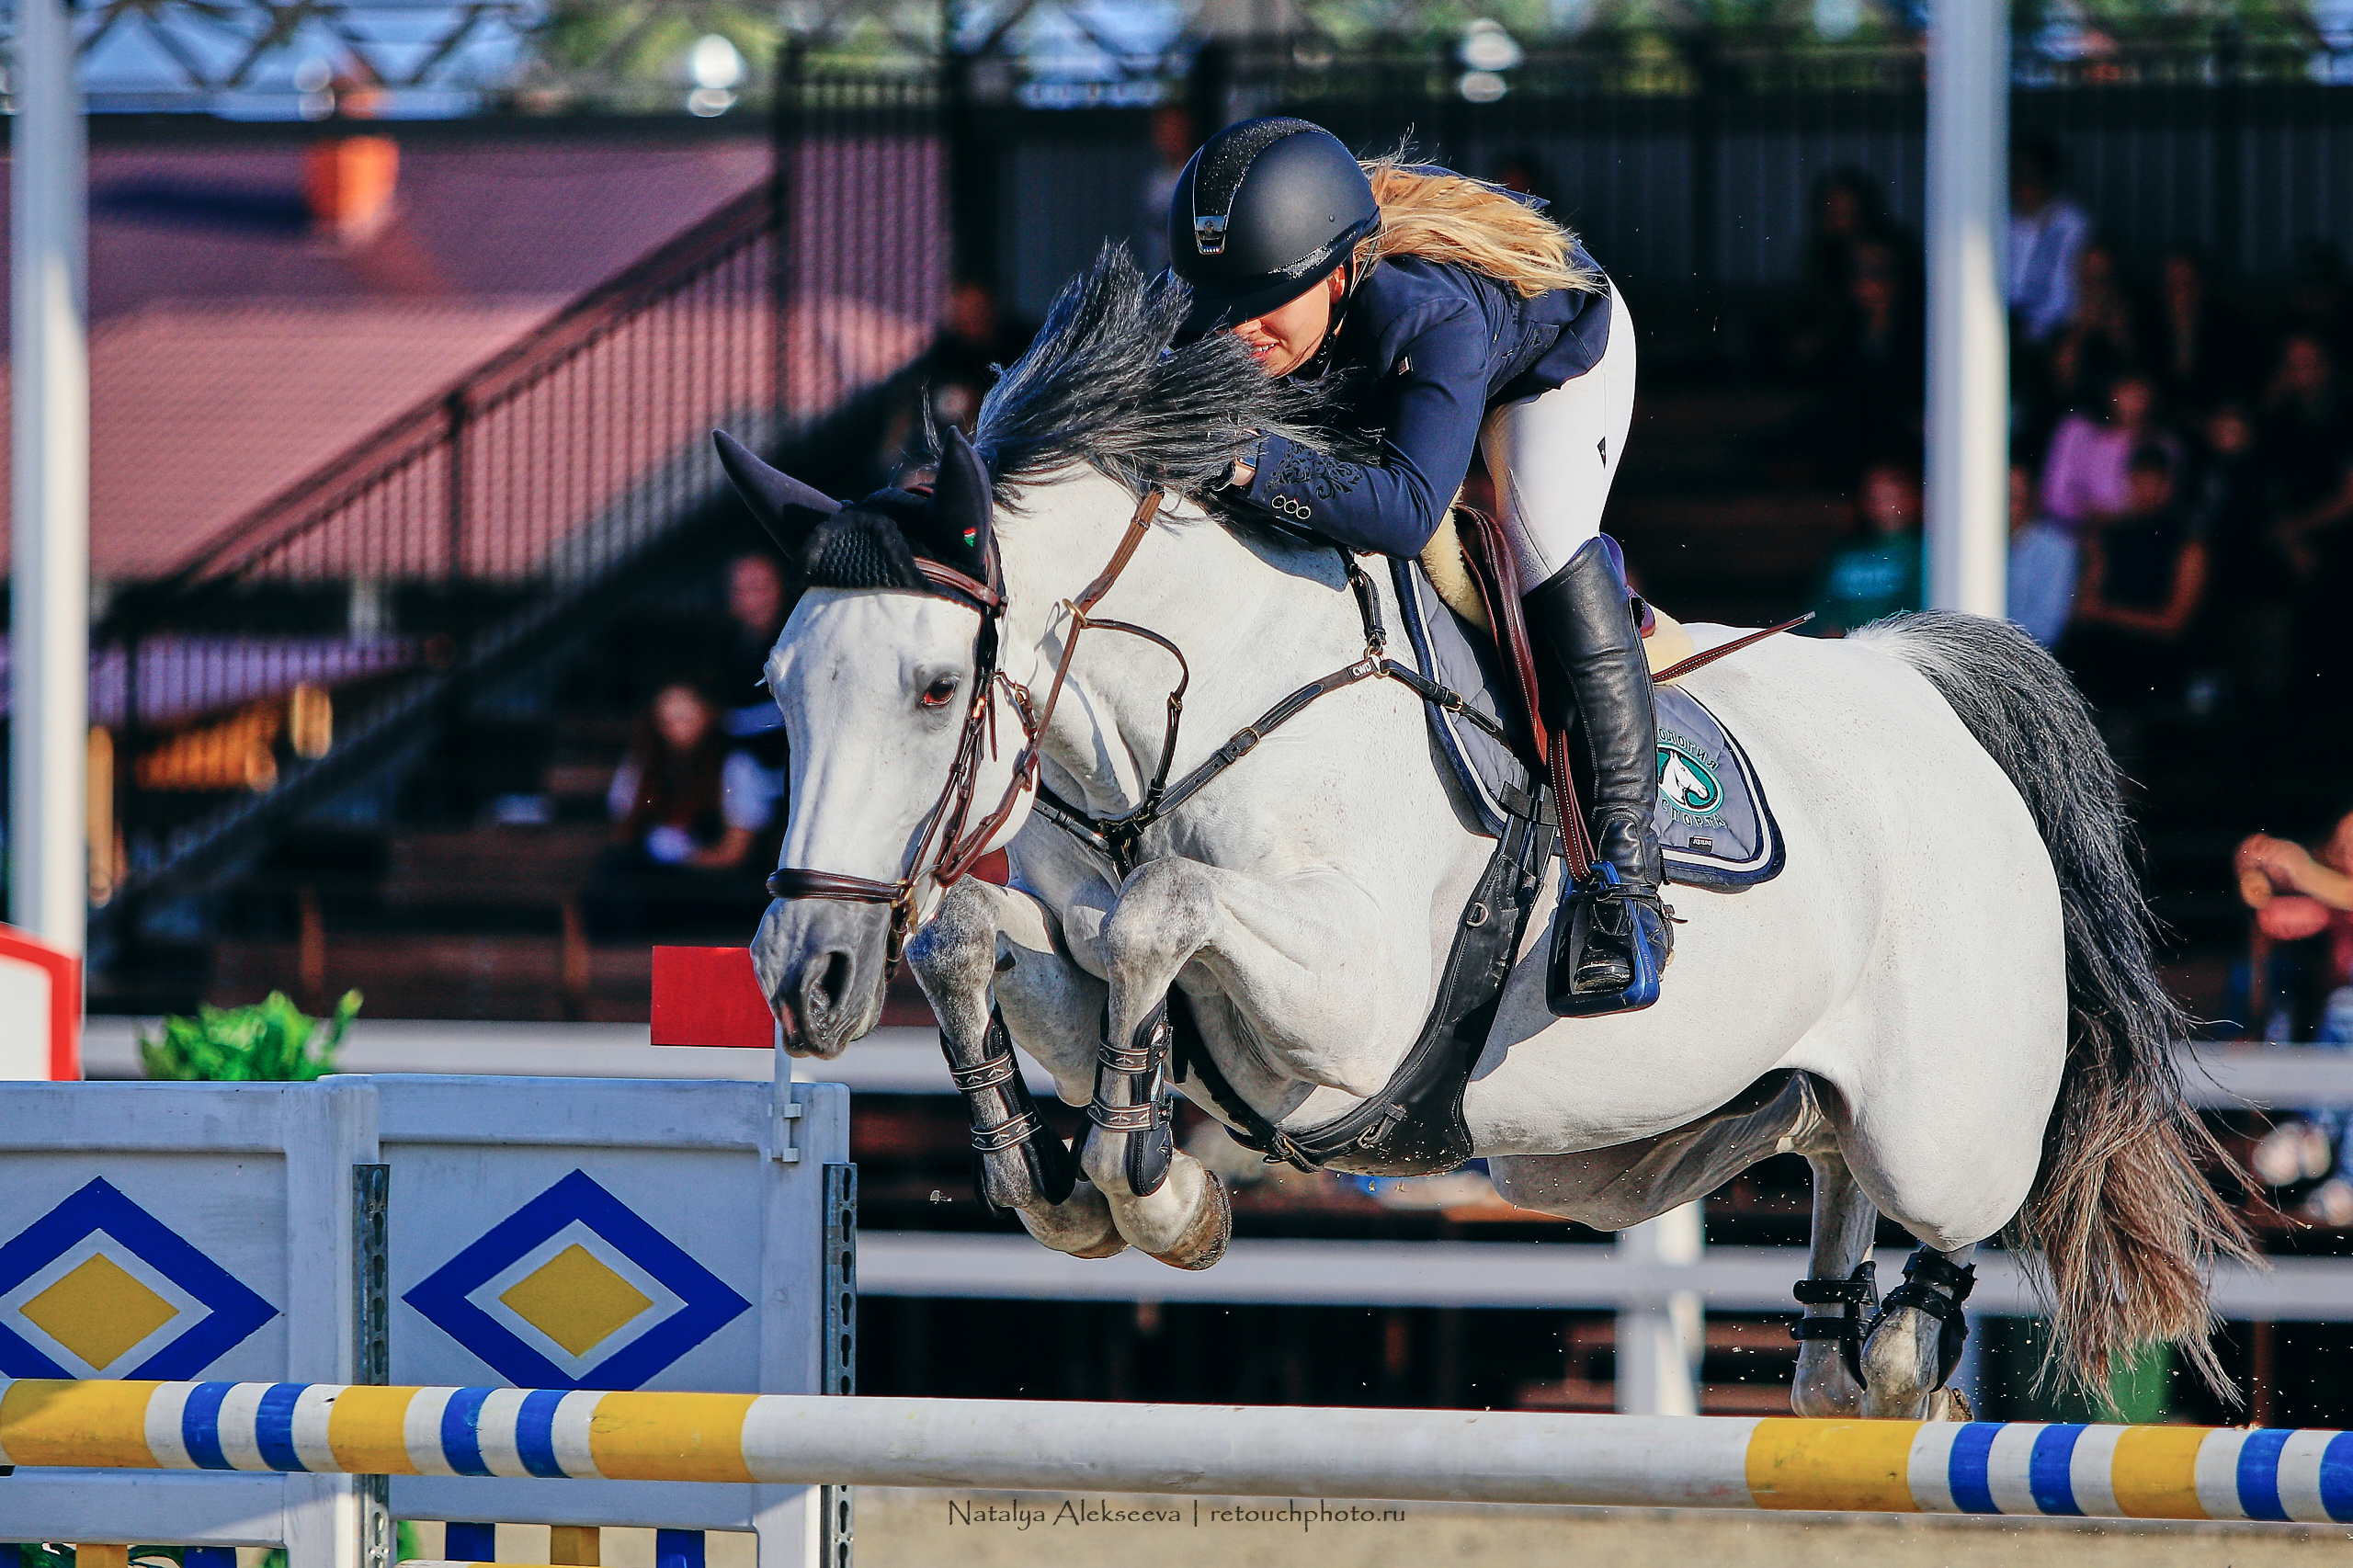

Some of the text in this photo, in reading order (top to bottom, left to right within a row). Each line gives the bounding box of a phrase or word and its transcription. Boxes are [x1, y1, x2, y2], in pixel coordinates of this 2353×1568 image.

[1352, 661, 1372, 676] CWD
[1657, 727, 1720, 770] ОЛОГИЯ
[1660, 797, 1726, 828] СПОРТА
